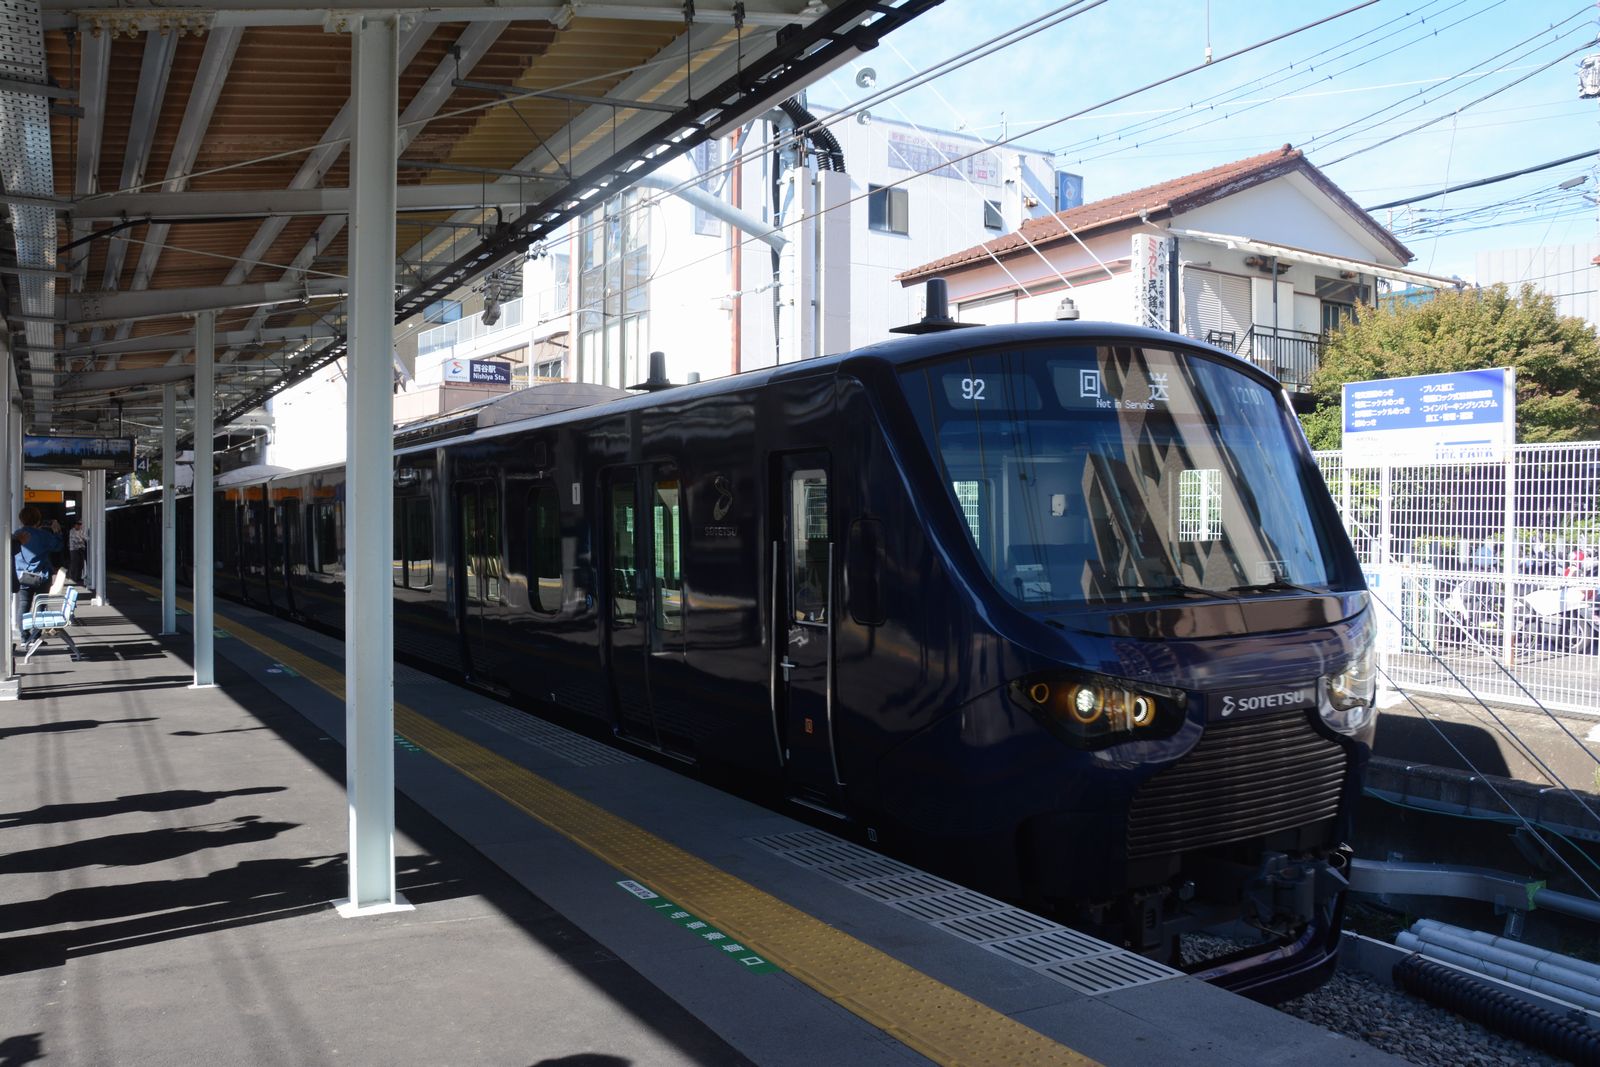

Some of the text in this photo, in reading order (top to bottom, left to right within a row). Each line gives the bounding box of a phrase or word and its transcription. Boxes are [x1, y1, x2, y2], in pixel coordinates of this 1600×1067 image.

[473, 363, 496, 373] 西谷駅
[473, 372, 494, 381] Nishiya
[961, 378, 985, 400] 92
[1079, 369, 1170, 401] 回送
[1096, 398, 1155, 410] Not in Service
[1238, 690, 1305, 712] SOTETSU
